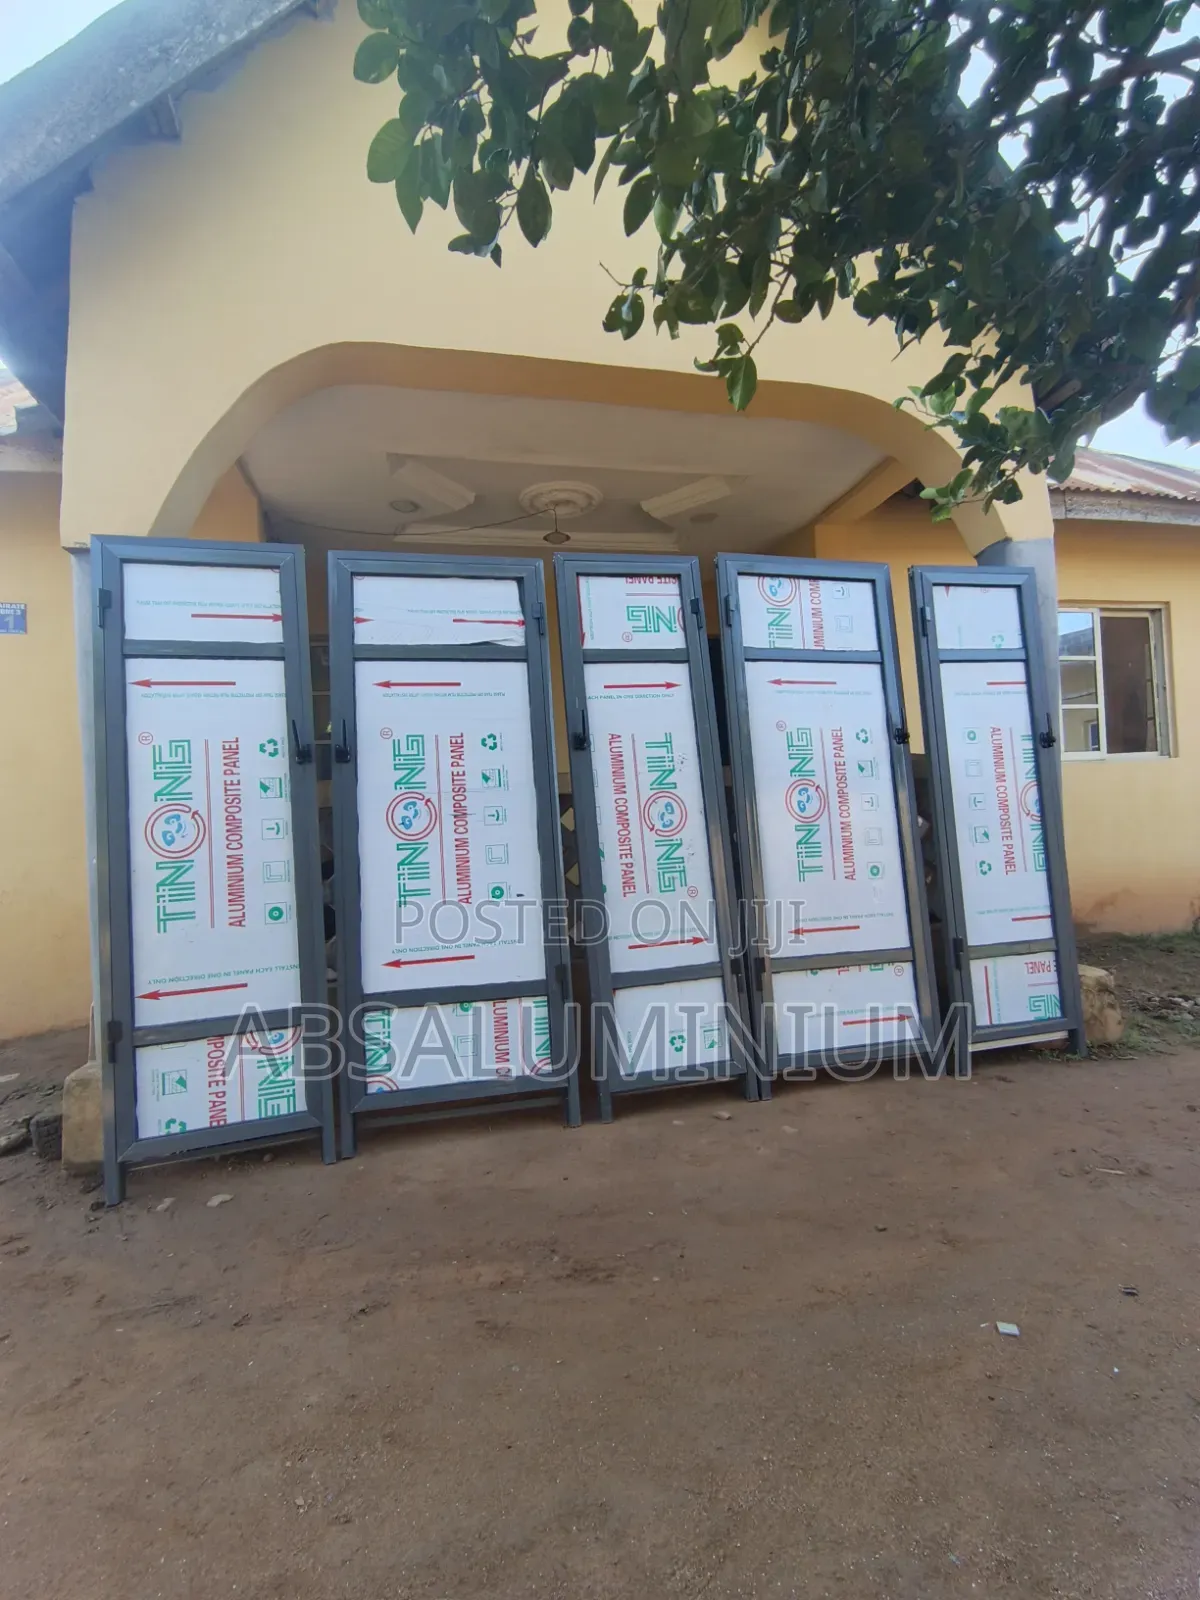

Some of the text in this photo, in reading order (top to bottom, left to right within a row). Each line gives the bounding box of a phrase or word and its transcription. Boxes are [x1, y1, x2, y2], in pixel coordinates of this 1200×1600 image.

[222, 737, 247, 928] ALUMINIUM COMPOSITE PANEL
[449, 732, 473, 905] ALUMINIUM COMPOSITE PANEL
[608, 733, 637, 898] ALUMINIUM COMPOSITE PANEL
[830, 726, 858, 881] ALUMINIUM COMPOSITE PANEL
[990, 726, 1017, 876] ALUMINIUM COMPOSITE PANEL
[168, 974, 206, 984] DIRECTION
[408, 945, 440, 953] DIRECTION
